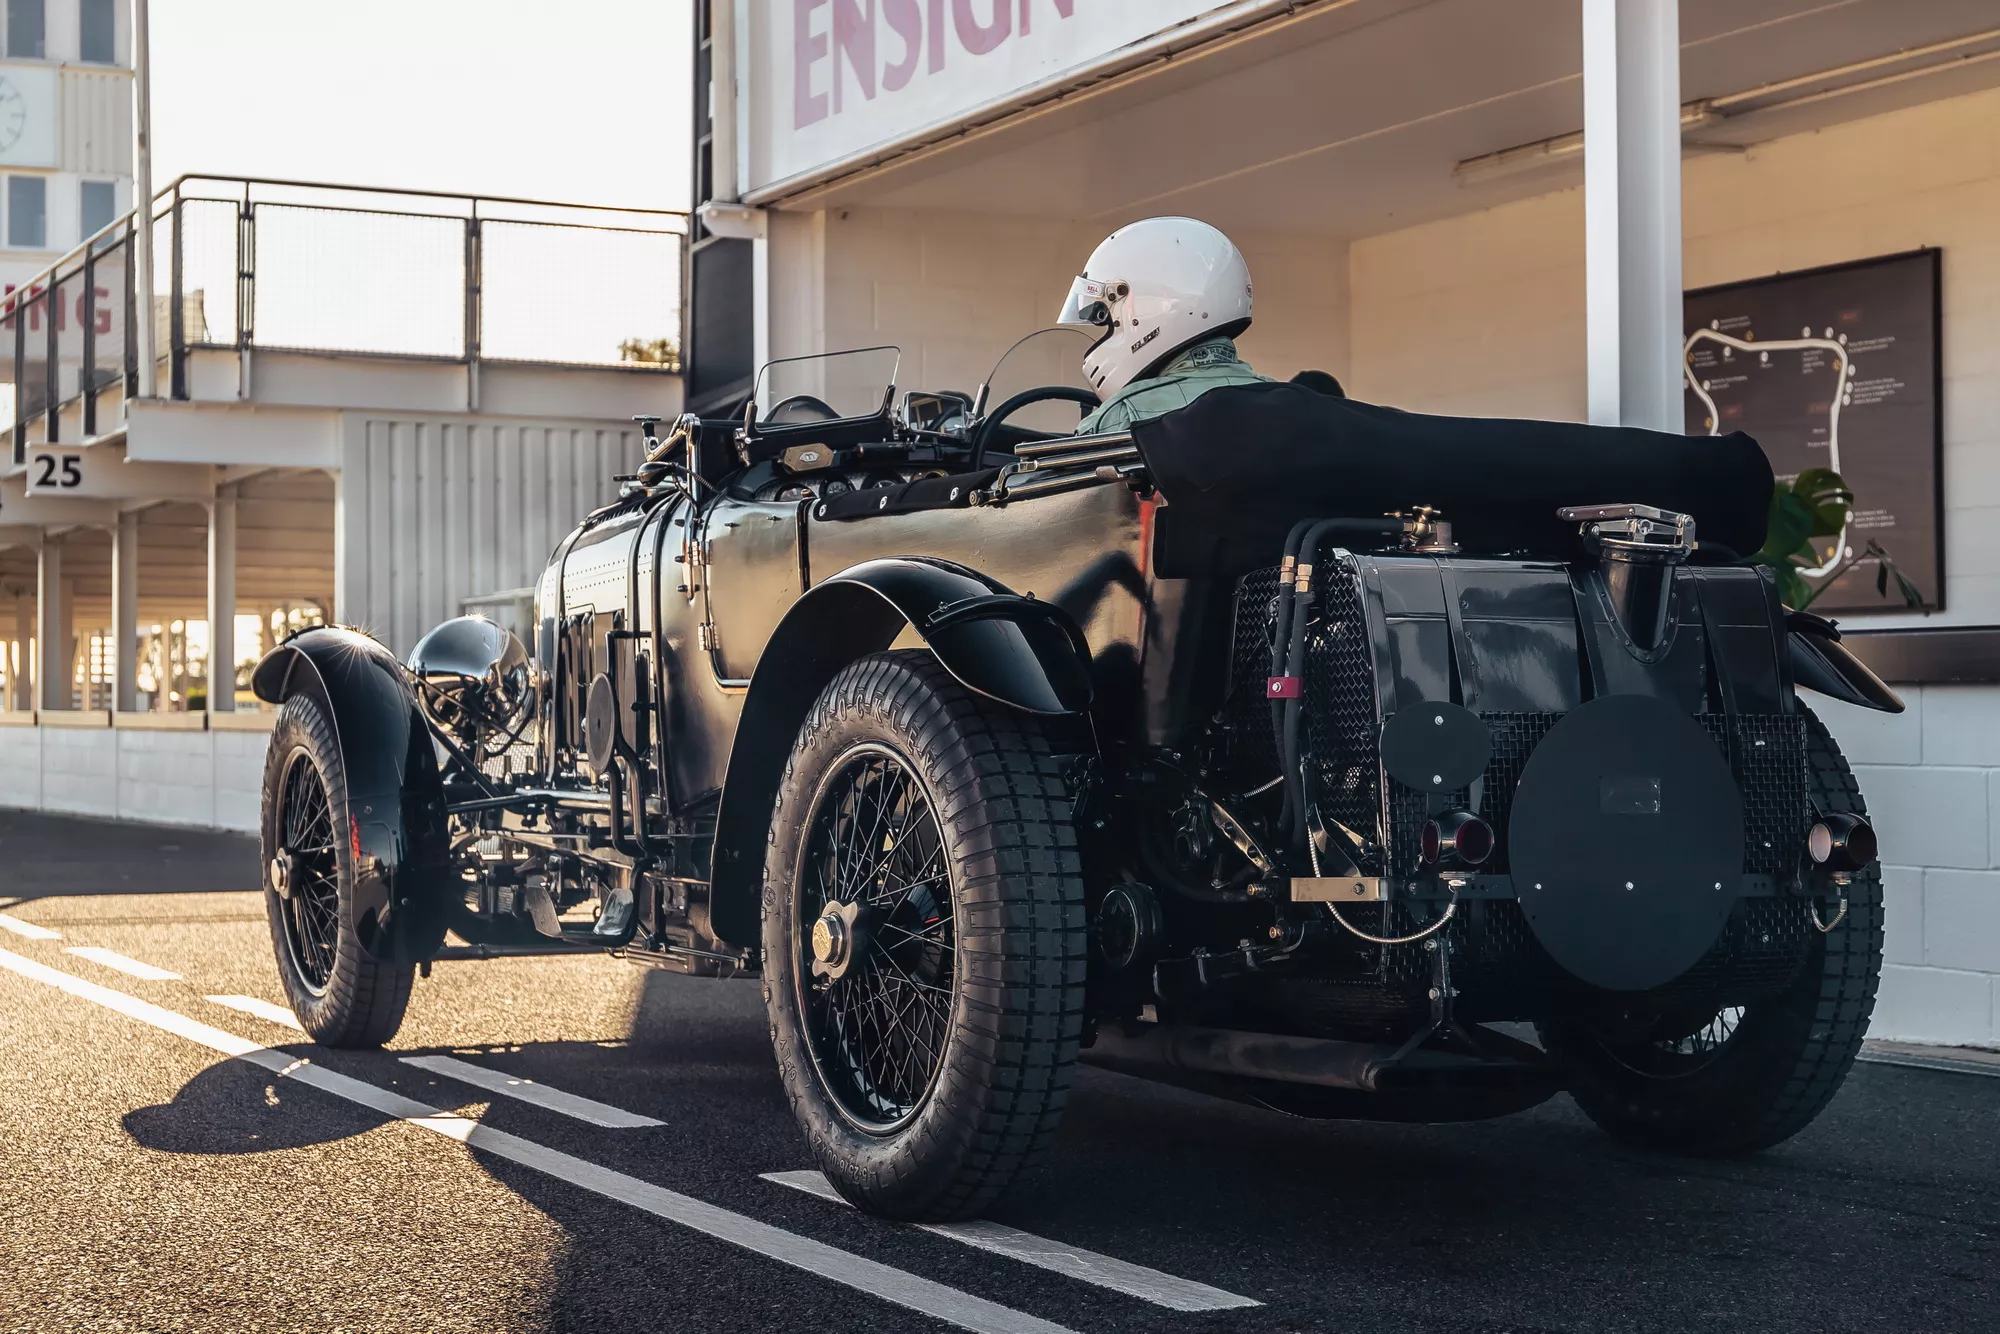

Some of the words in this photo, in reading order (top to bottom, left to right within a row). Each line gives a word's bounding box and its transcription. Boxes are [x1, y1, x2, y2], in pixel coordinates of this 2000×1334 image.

[794, 0, 1073, 131] ENSI
[34, 453, 82, 488] 25
[806, 693, 933, 777] BLOCKLEY
